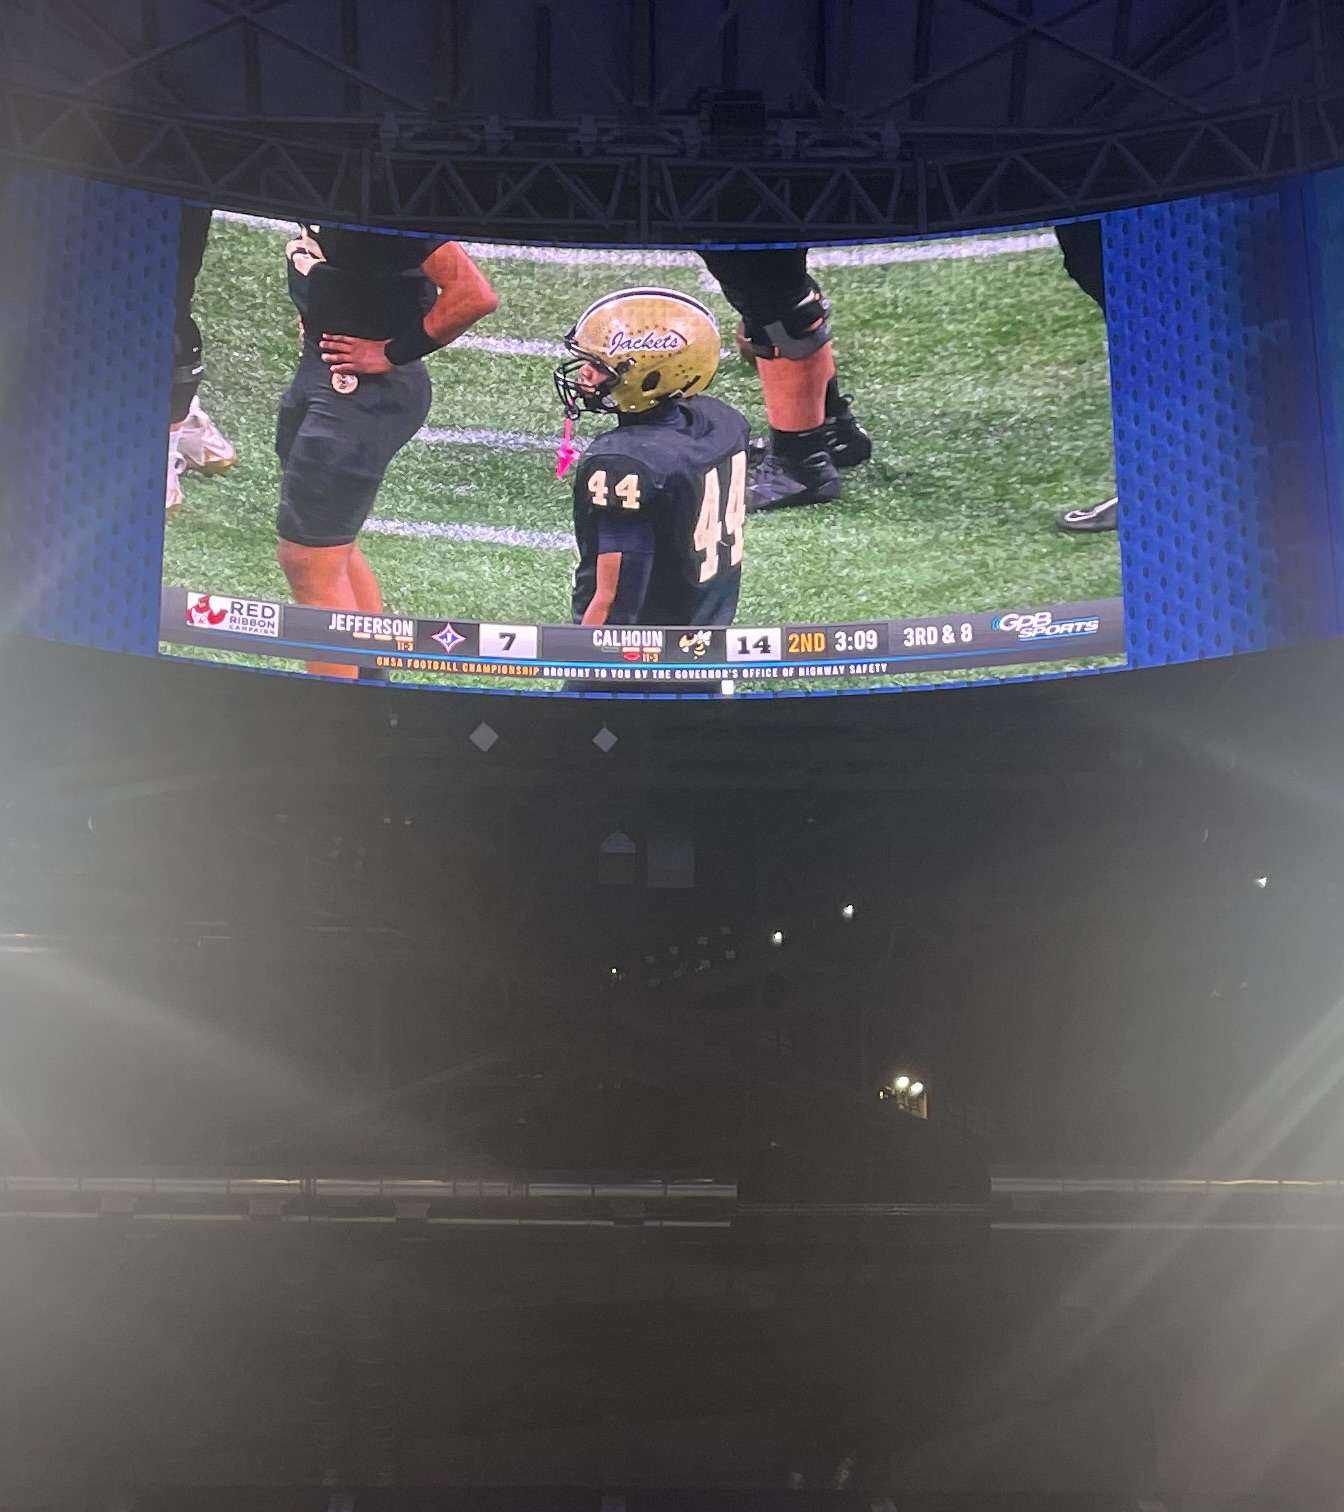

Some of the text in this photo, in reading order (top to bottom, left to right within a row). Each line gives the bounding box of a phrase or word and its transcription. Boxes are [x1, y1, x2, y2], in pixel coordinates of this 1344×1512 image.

[609, 330, 680, 355] Jackets
[587, 469, 641, 509] 44
[693, 450, 747, 584] 44
[229, 602, 276, 620] RED
[228, 625, 276, 637] CAMPAIGN
[229, 615, 276, 630] RIBBON
[328, 613, 414, 637] JEFFERSON
[998, 611, 1052, 632] GPB
[1019, 619, 1100, 639] SPORTS
[499, 632, 516, 651] 7
[592, 630, 663, 648] CALHOUN
[736, 635, 772, 655] 14
[788, 633, 826, 653] 2ND
[834, 629, 878, 651] 3:09
[903, 623, 973, 647] 3RD & 8
[376, 656, 888, 680] GHSA FOOTBALL CHAMPIONSHIP BROUGHT TO YOU BY THE GOVERNOR'S OFFICE OF HIGHWAY SAFETY
